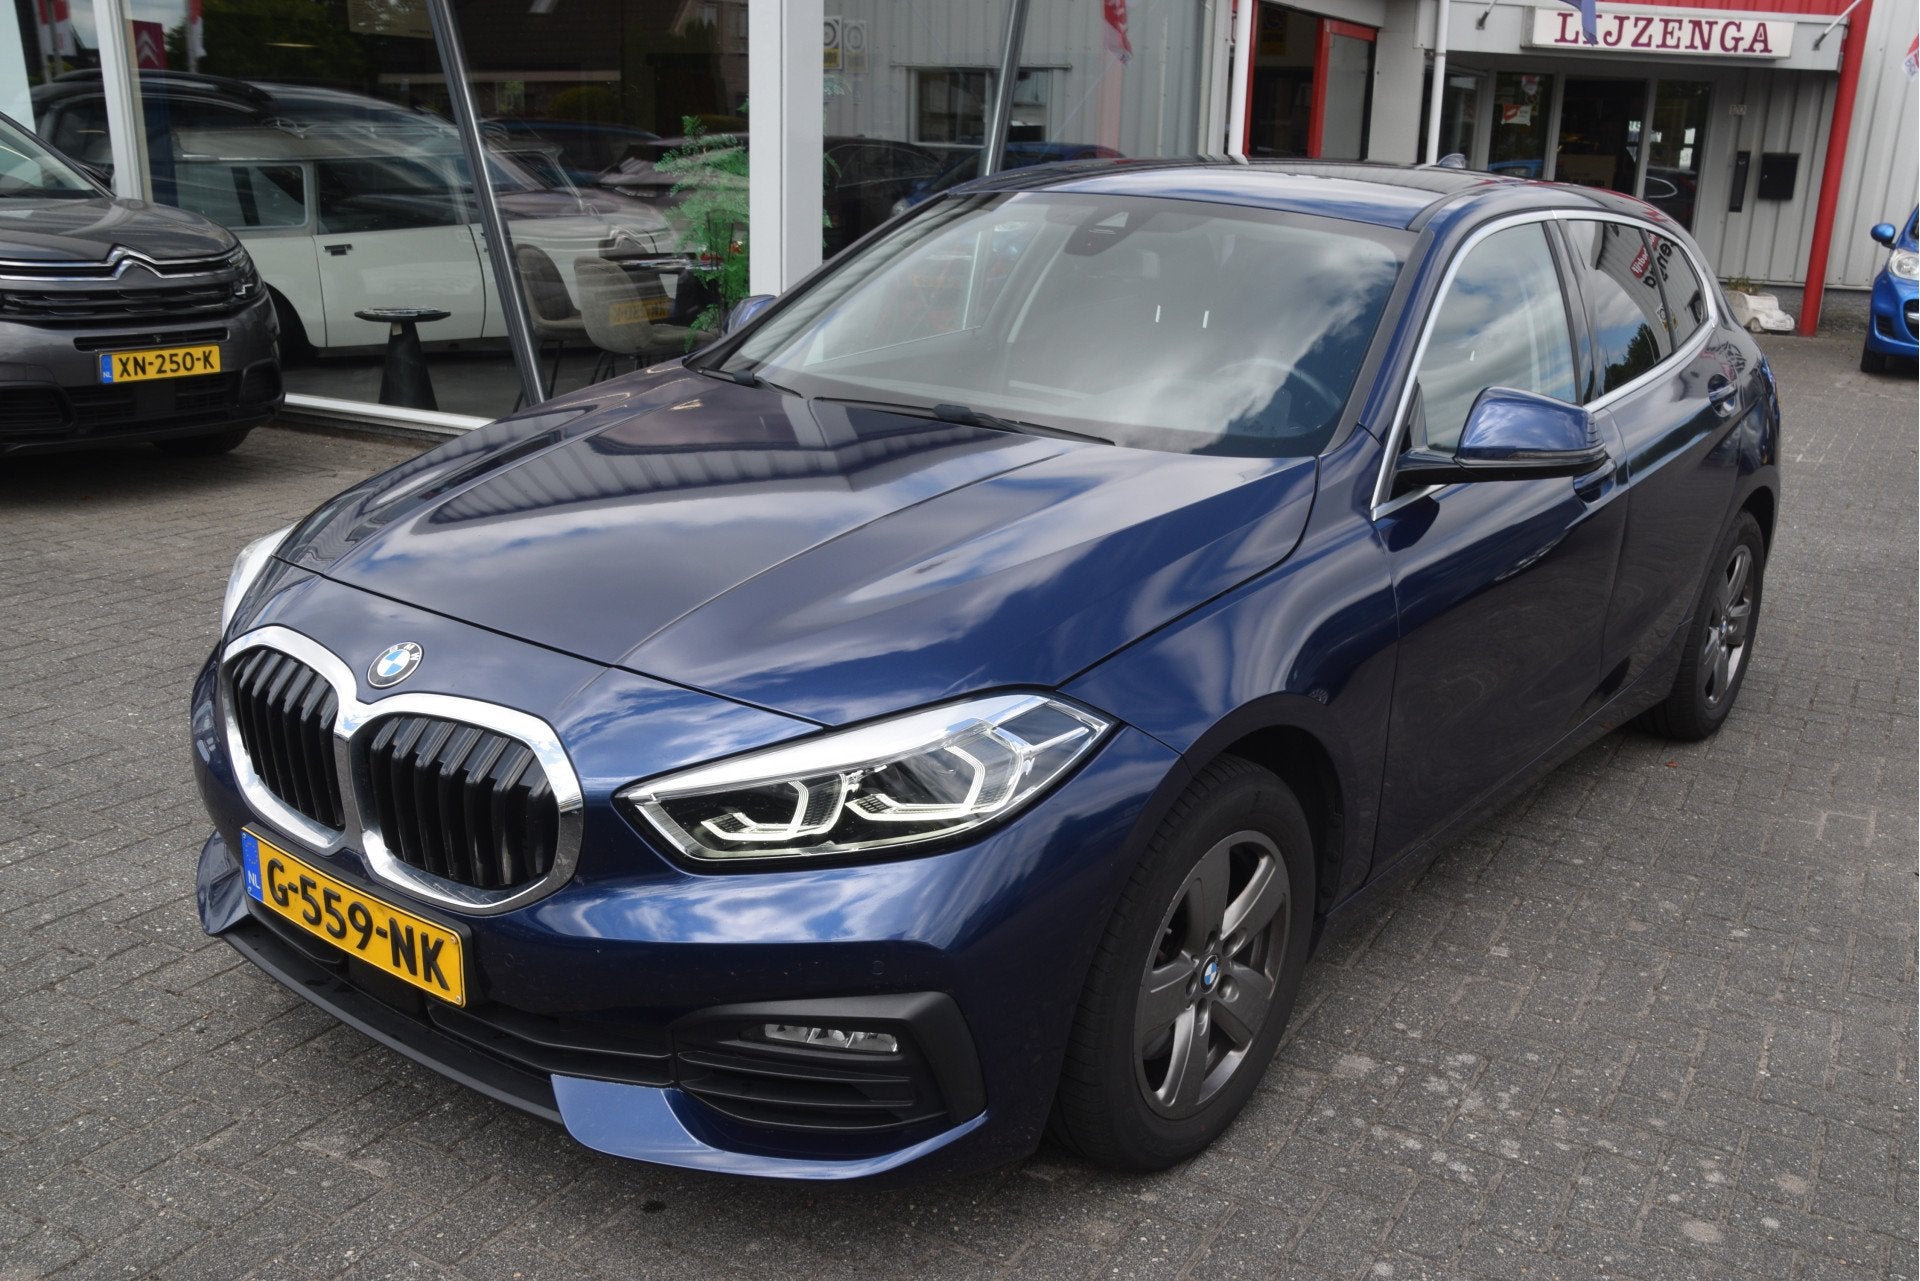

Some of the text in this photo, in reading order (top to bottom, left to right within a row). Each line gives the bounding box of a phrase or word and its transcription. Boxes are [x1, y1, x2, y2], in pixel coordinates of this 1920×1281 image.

[1554, 12, 1773, 54] LJZENGA
[118, 350, 215, 377] XN-250-K
[247, 870, 261, 890] NL
[267, 857, 451, 991] G-559-NK
